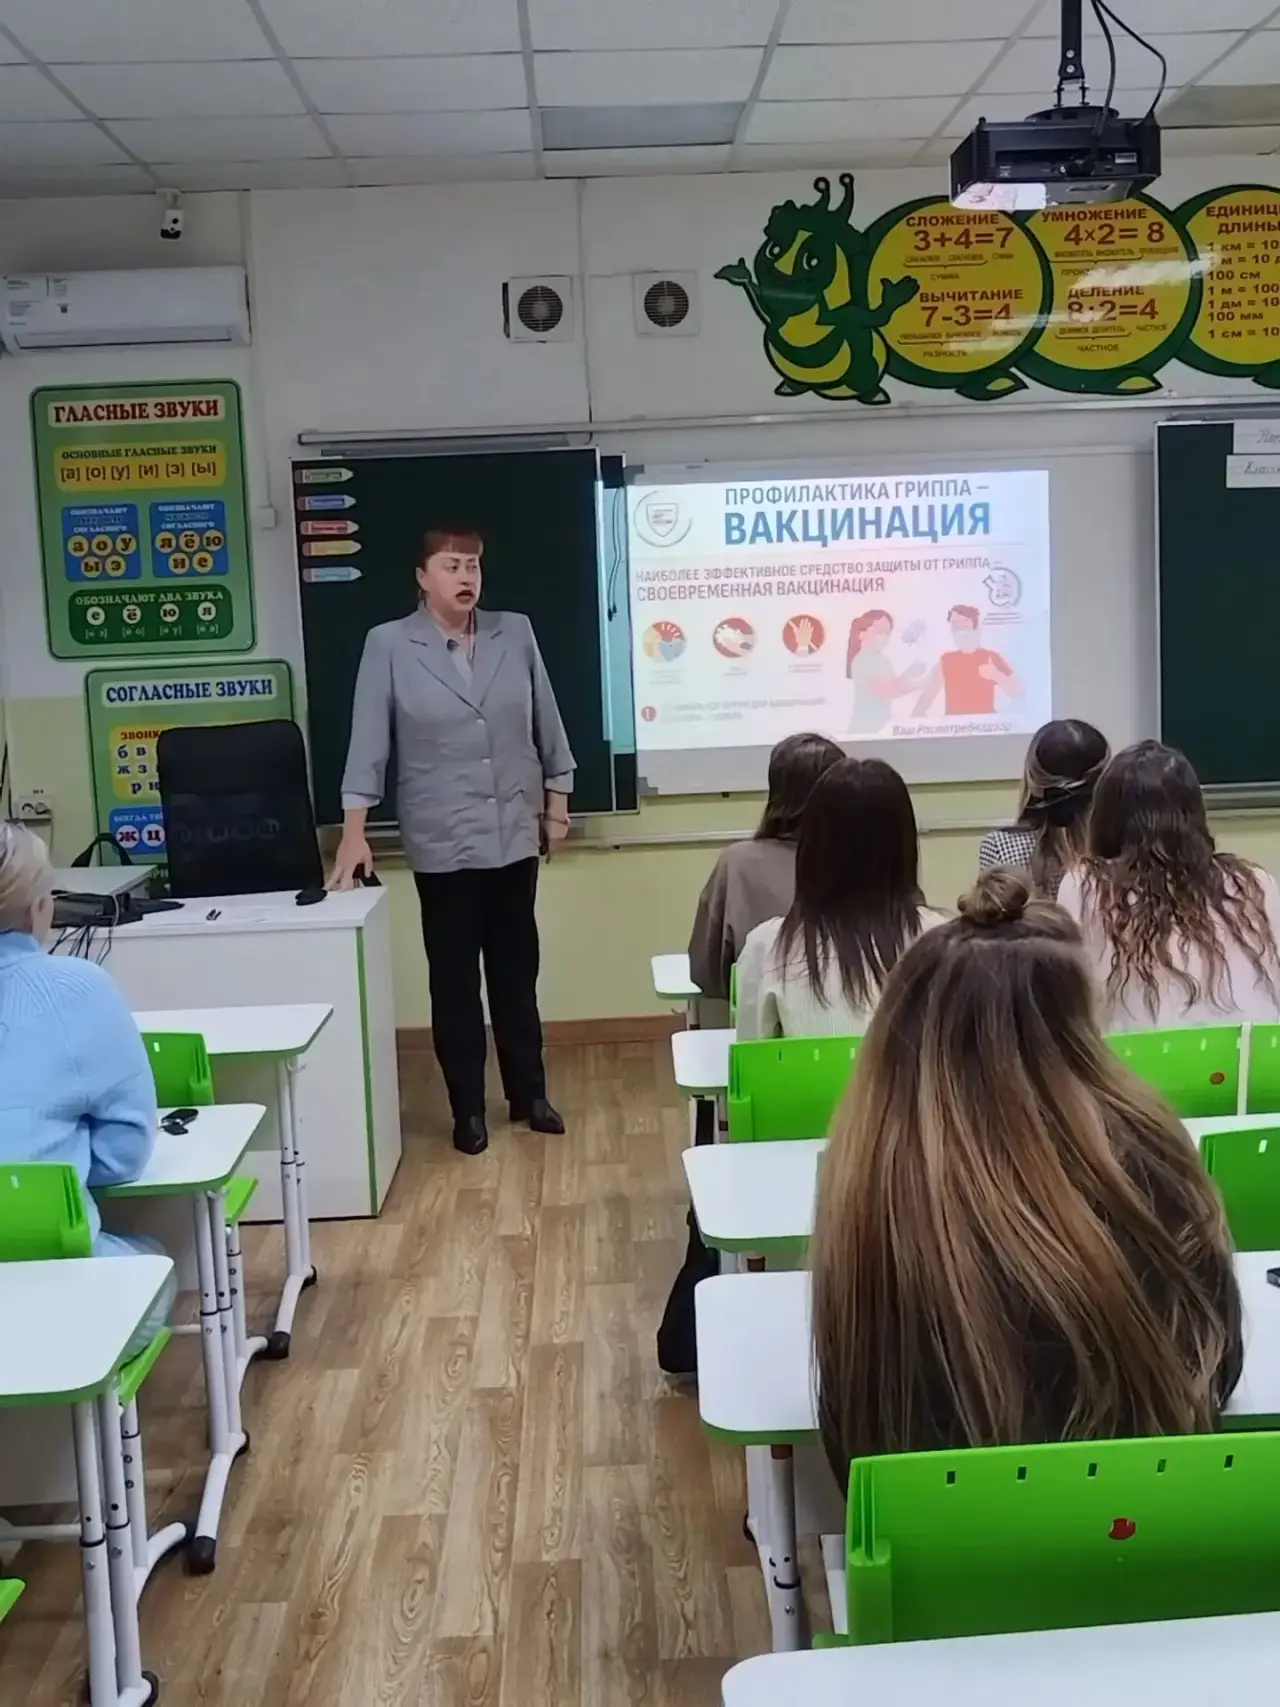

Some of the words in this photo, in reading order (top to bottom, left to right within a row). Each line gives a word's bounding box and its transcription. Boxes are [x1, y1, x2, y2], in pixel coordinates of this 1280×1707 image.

[1041, 208, 1148, 223] УМНОЖЕНИЕ
[1206, 204, 1280, 218] ЕДИНИЦ
[906, 213, 1000, 227] СЛОЖЕНИЕ
[914, 227, 1014, 251] 3+4=7
[1252, 254, 1270, 264] 10
[1208, 270, 1235, 280] 100
[1240, 271, 1261, 280] см
[920, 289, 1024, 303] ВЫЧИТАНИЕ
[1068, 286, 1145, 300] ДЕЛЕНИЕ
[920, 303, 1014, 328] 7-3=4
[1208, 312, 1235, 322] 100
[1208, 329, 1215, 339] 1
[1221, 330, 1242, 338] см
[54, 402, 149, 423] ГЛАСНЫЕ
[154, 399, 219, 418] ЗВУКИ
[62, 448, 122, 460] ОСНОВНЫЕ
[124, 446, 179, 458] ГЛАСНЫЕ
[180, 444, 216, 455] ЗВУКИ
[86, 465, 106, 481] [о]
[138, 463, 159, 479] [и]
[191, 460, 217, 477] [ы]
[725, 481, 889, 506] ПРОФИЛАКТИКА
[895, 479, 971, 499] ГРИППА
[725, 502, 990, 547] ВАКЦИНАЦИЯ
[72, 541, 85, 552] а
[96, 540, 108, 551] о
[120, 538, 134, 551] у
[183, 533, 195, 548] ё
[206, 535, 222, 547] ю
[84, 561, 100, 572] ы
[636, 568, 700, 583] НАИБОЛЕЕ
[704, 564, 796, 580] ЭФФЕКТИВНОЕ
[800, 561, 863, 577] СРЕДСТВО
[867, 558, 921, 574] ЗАЩИТЫ
[924, 558, 939, 571] ОТ
[943, 556, 990, 570] ГРИППА
[637, 582, 773, 602] СВОЕВРЕМЕННАЯ
[776, 576, 885, 597] ВАКЦИНАЦИЯ
[76, 594, 155, 606] ОБОЗНАЧАЮТ
[159, 592, 183, 602] ДВА
[185, 590, 223, 601] ЗВУКА
[106, 682, 211, 703] СОГЛАСНЫЕ
[216, 679, 273, 696] ЗВУКИ
[117, 745, 129, 759] б
[136, 747, 147, 756] в
[117, 764, 130, 775] ж
[137, 764, 148, 774] з
[131, 782, 142, 795] р
[118, 830, 138, 842] ж
[147, 829, 162, 842] ц
